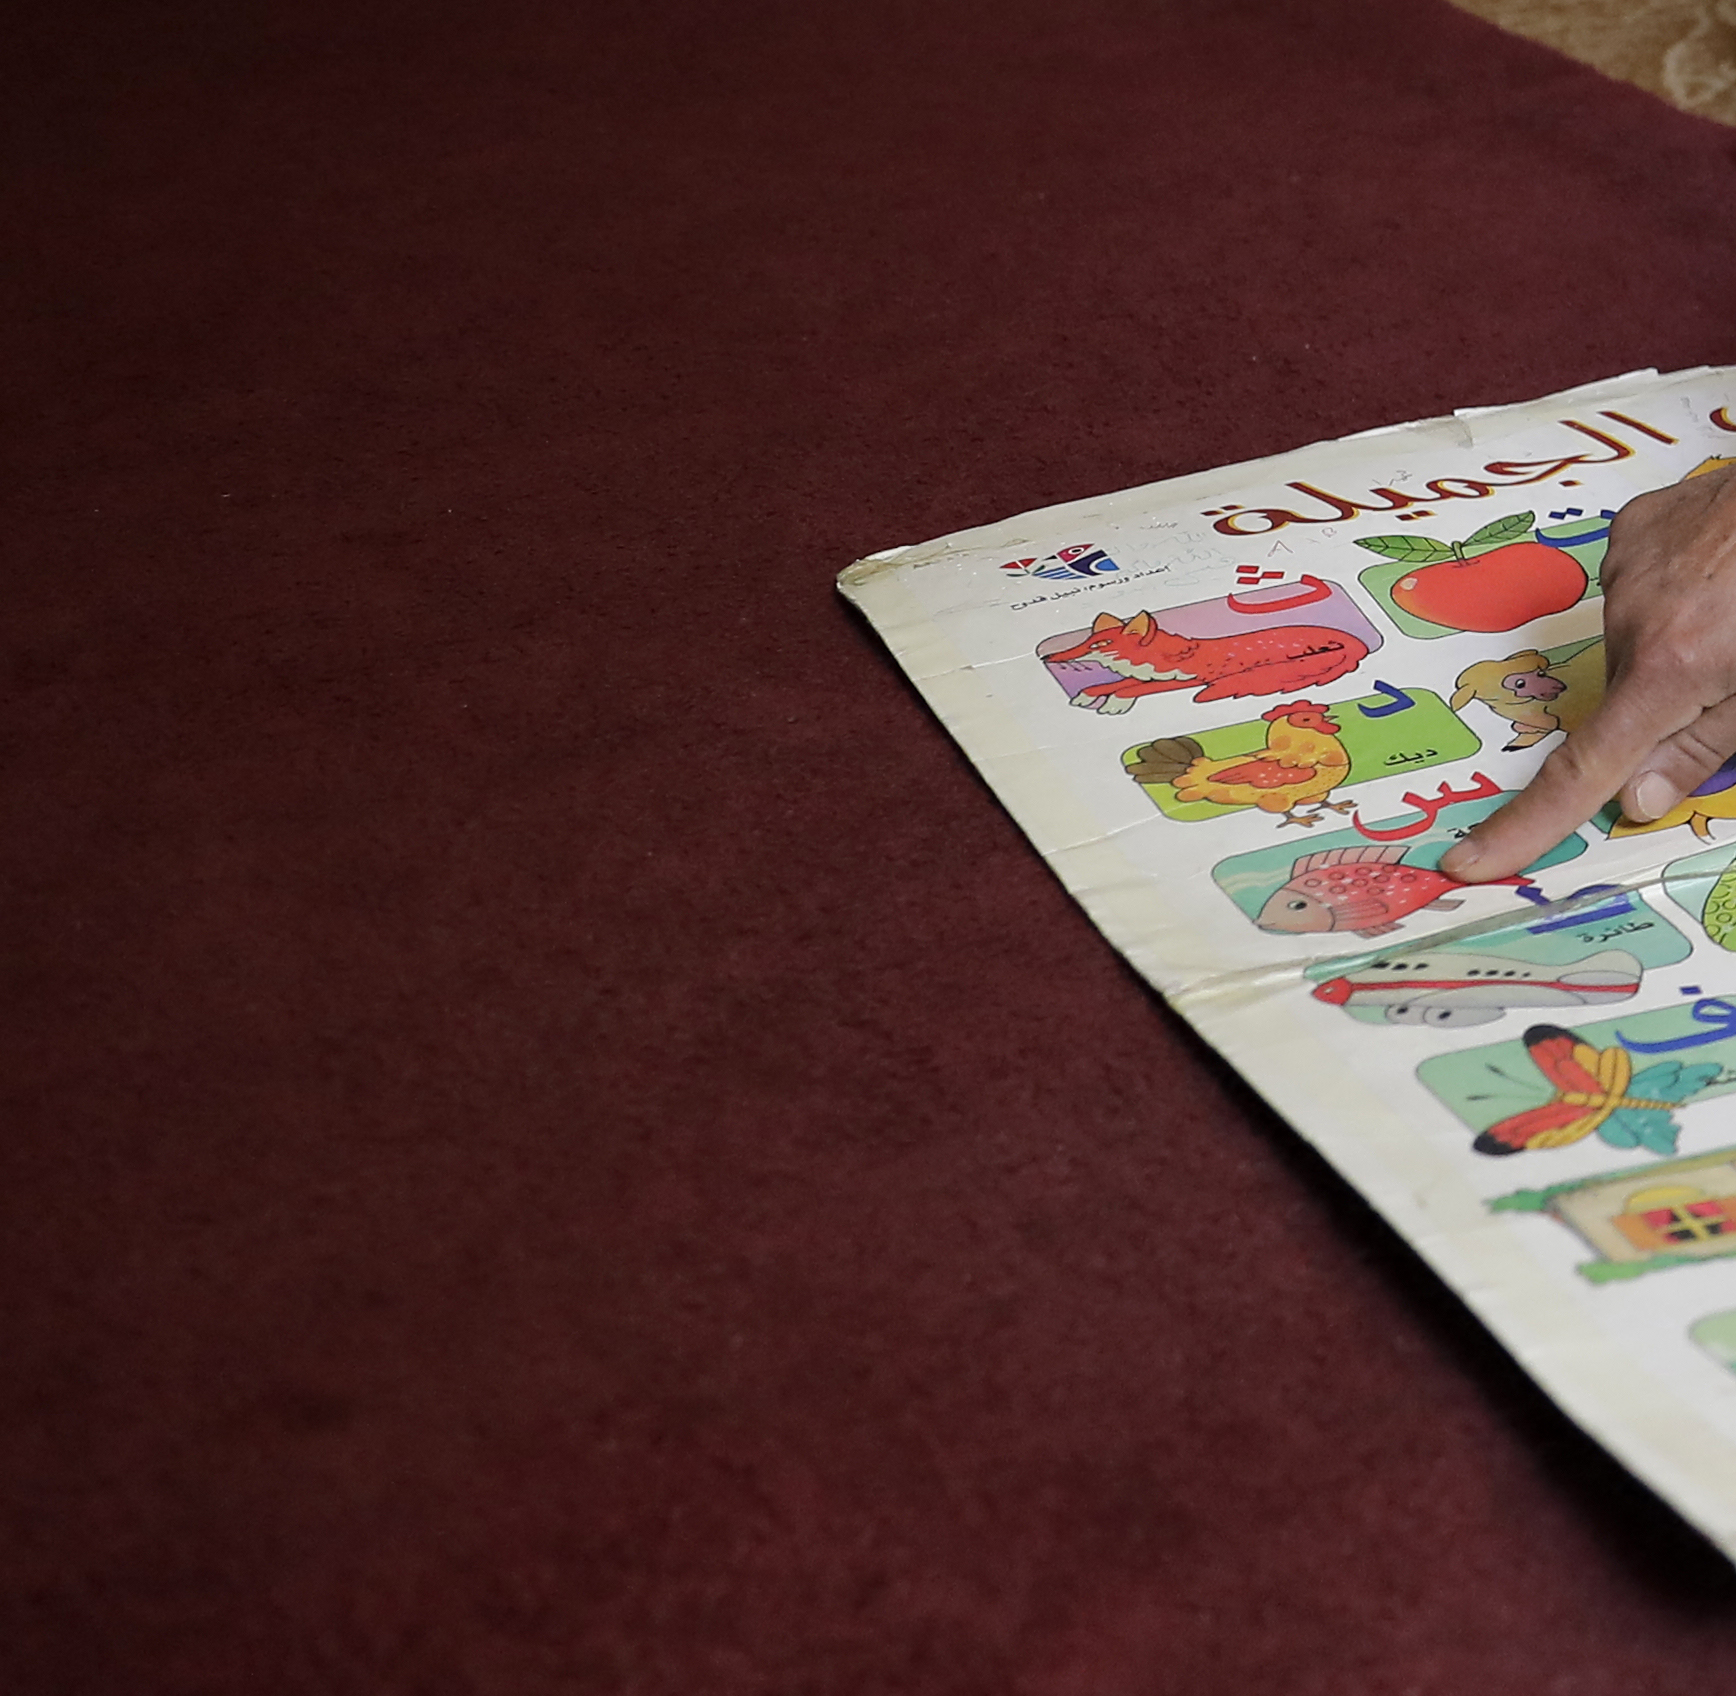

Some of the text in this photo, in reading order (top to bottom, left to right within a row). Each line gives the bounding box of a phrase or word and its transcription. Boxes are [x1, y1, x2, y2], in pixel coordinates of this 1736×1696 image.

[1201, 410, 1680, 536] الجميلة
[1228, 565, 1333, 615] ث
[1286, 641, 1345, 661] ثعلب
[1358, 680, 1415, 718] د
[1383, 747, 1439, 766] ديك
[1352, 771, 1503, 842] س
[1579, 920, 1655, 944] طائرة
